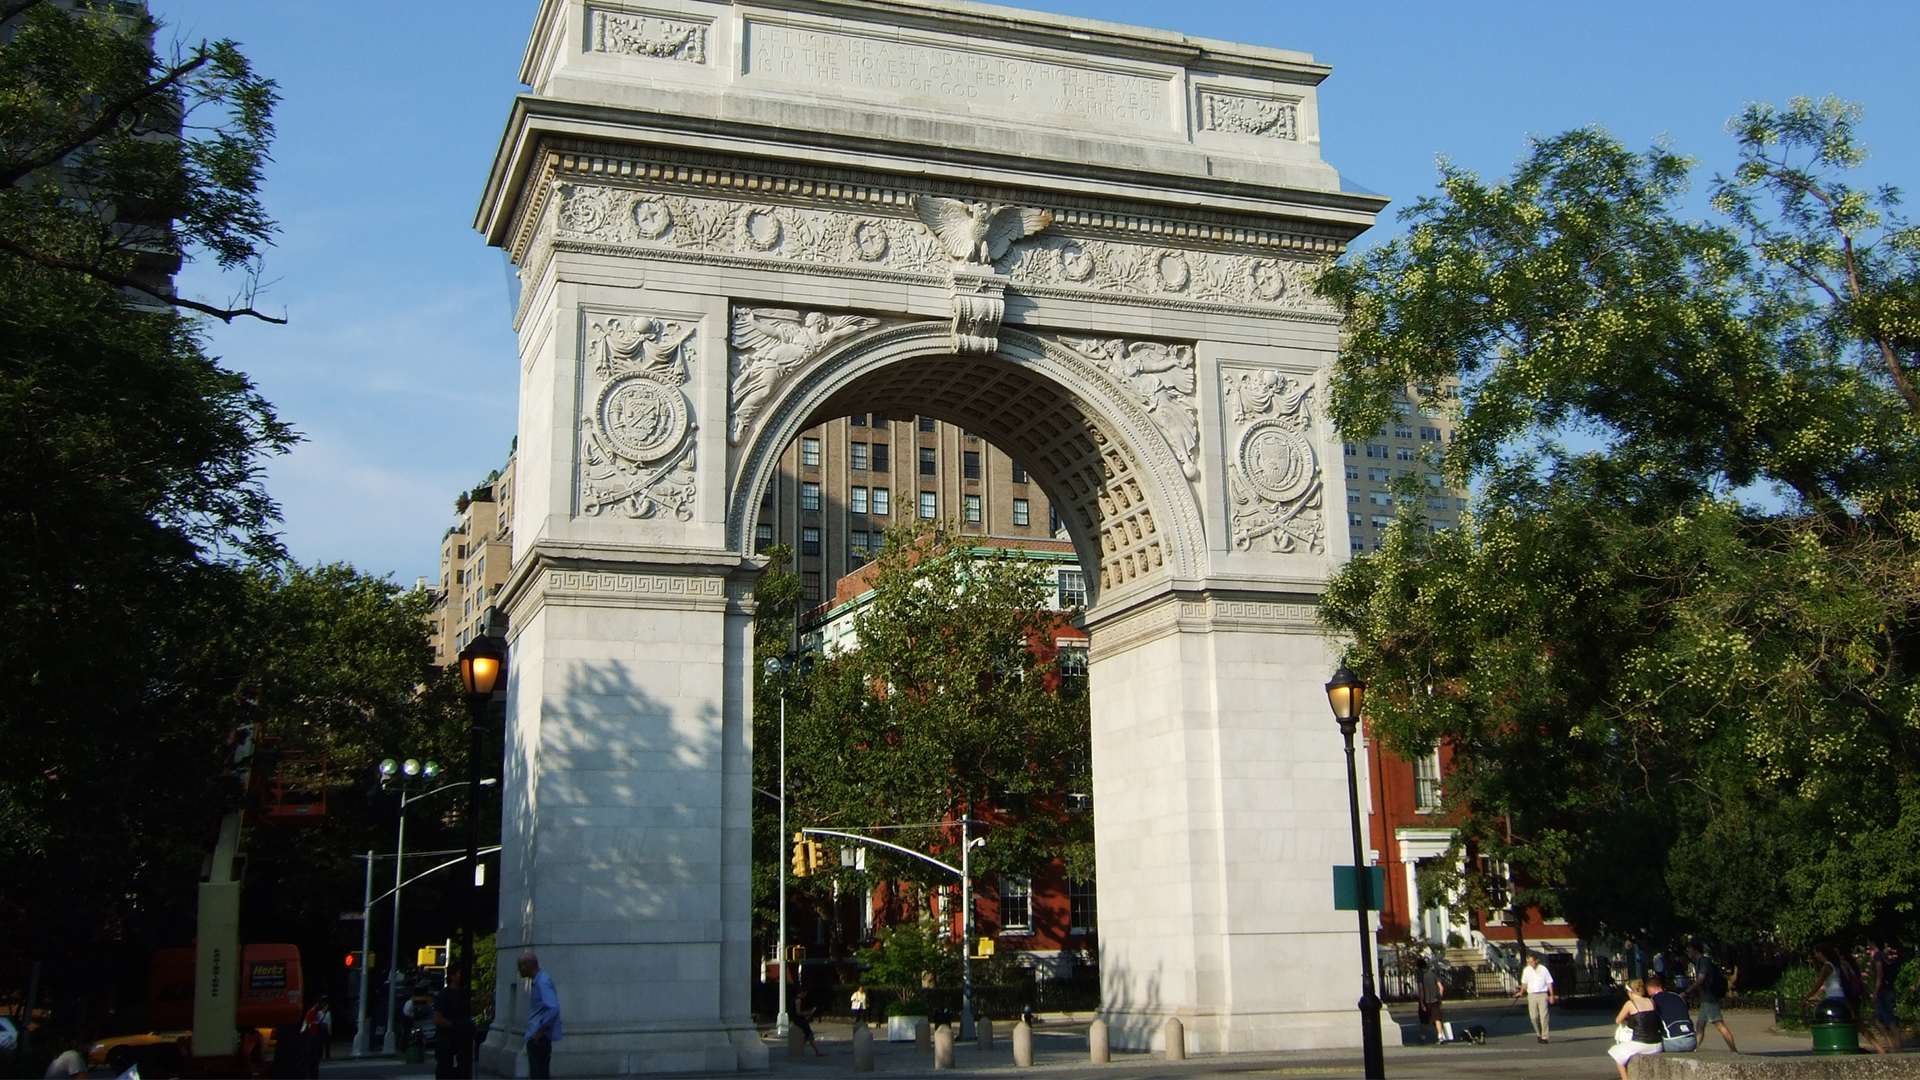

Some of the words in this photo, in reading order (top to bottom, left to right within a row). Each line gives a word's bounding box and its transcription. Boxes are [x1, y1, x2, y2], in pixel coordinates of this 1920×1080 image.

[758, 28, 793, 44] LET
[798, 33, 816, 47] US
[823, 36, 873, 54] RAISE
[878, 45, 892, 57] A
[898, 47, 989, 71] STANDARD
[995, 60, 1019, 74] TO
[1023, 63, 1079, 84] WHICH
[1085, 72, 1117, 88] THE
[1122, 77, 1160, 94] WISE
[758, 43, 794, 59] AND
[802, 48, 837, 65] THE
[848, 54, 919, 75] HONEST
[929, 66, 968, 83] CAN
[976, 71, 1034, 91] REPAIR
[1063, 83, 1096, 100] THE
[1106, 88, 1161, 108] EVENT
[758, 58, 773, 72] IS
[780, 60, 797, 75] IN
[805, 63, 841, 81] THE
[851, 70, 901, 88] HAND
[909, 78, 932, 93] OF
[940, 82, 978, 98] GOD
[1050, 95, 1163, 122] WASHINGTON
[253, 965, 285, 975] Hertz
